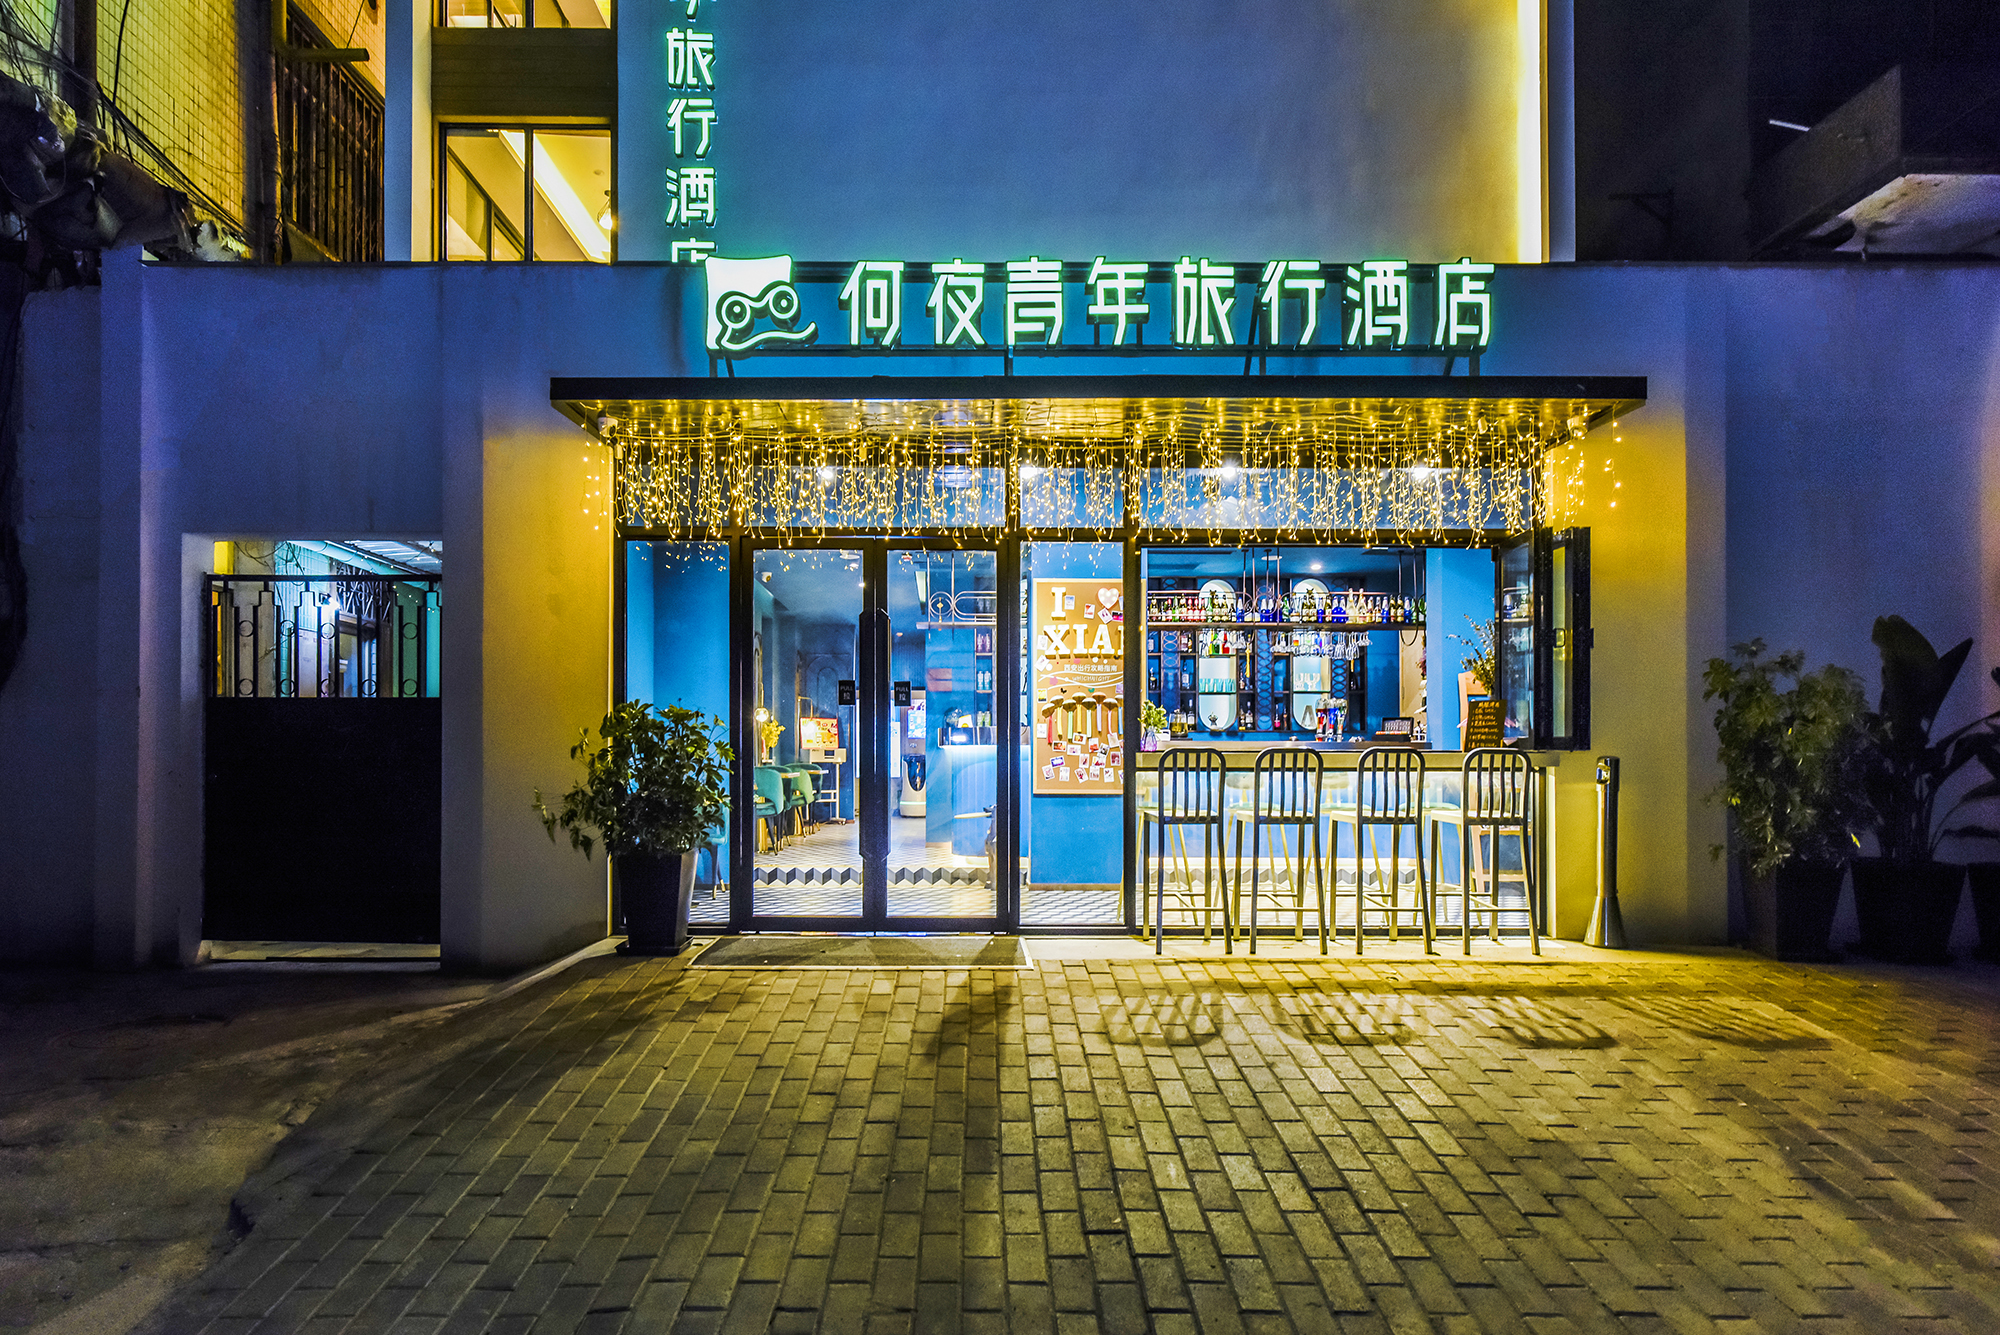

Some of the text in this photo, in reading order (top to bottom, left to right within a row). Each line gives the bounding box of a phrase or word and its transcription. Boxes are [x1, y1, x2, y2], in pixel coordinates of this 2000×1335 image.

[839, 257, 1496, 347] 何夜青年旅行酒店
[1051, 587, 1066, 619] I
[1064, 664, 1118, 672] 西安出行攻略指南
